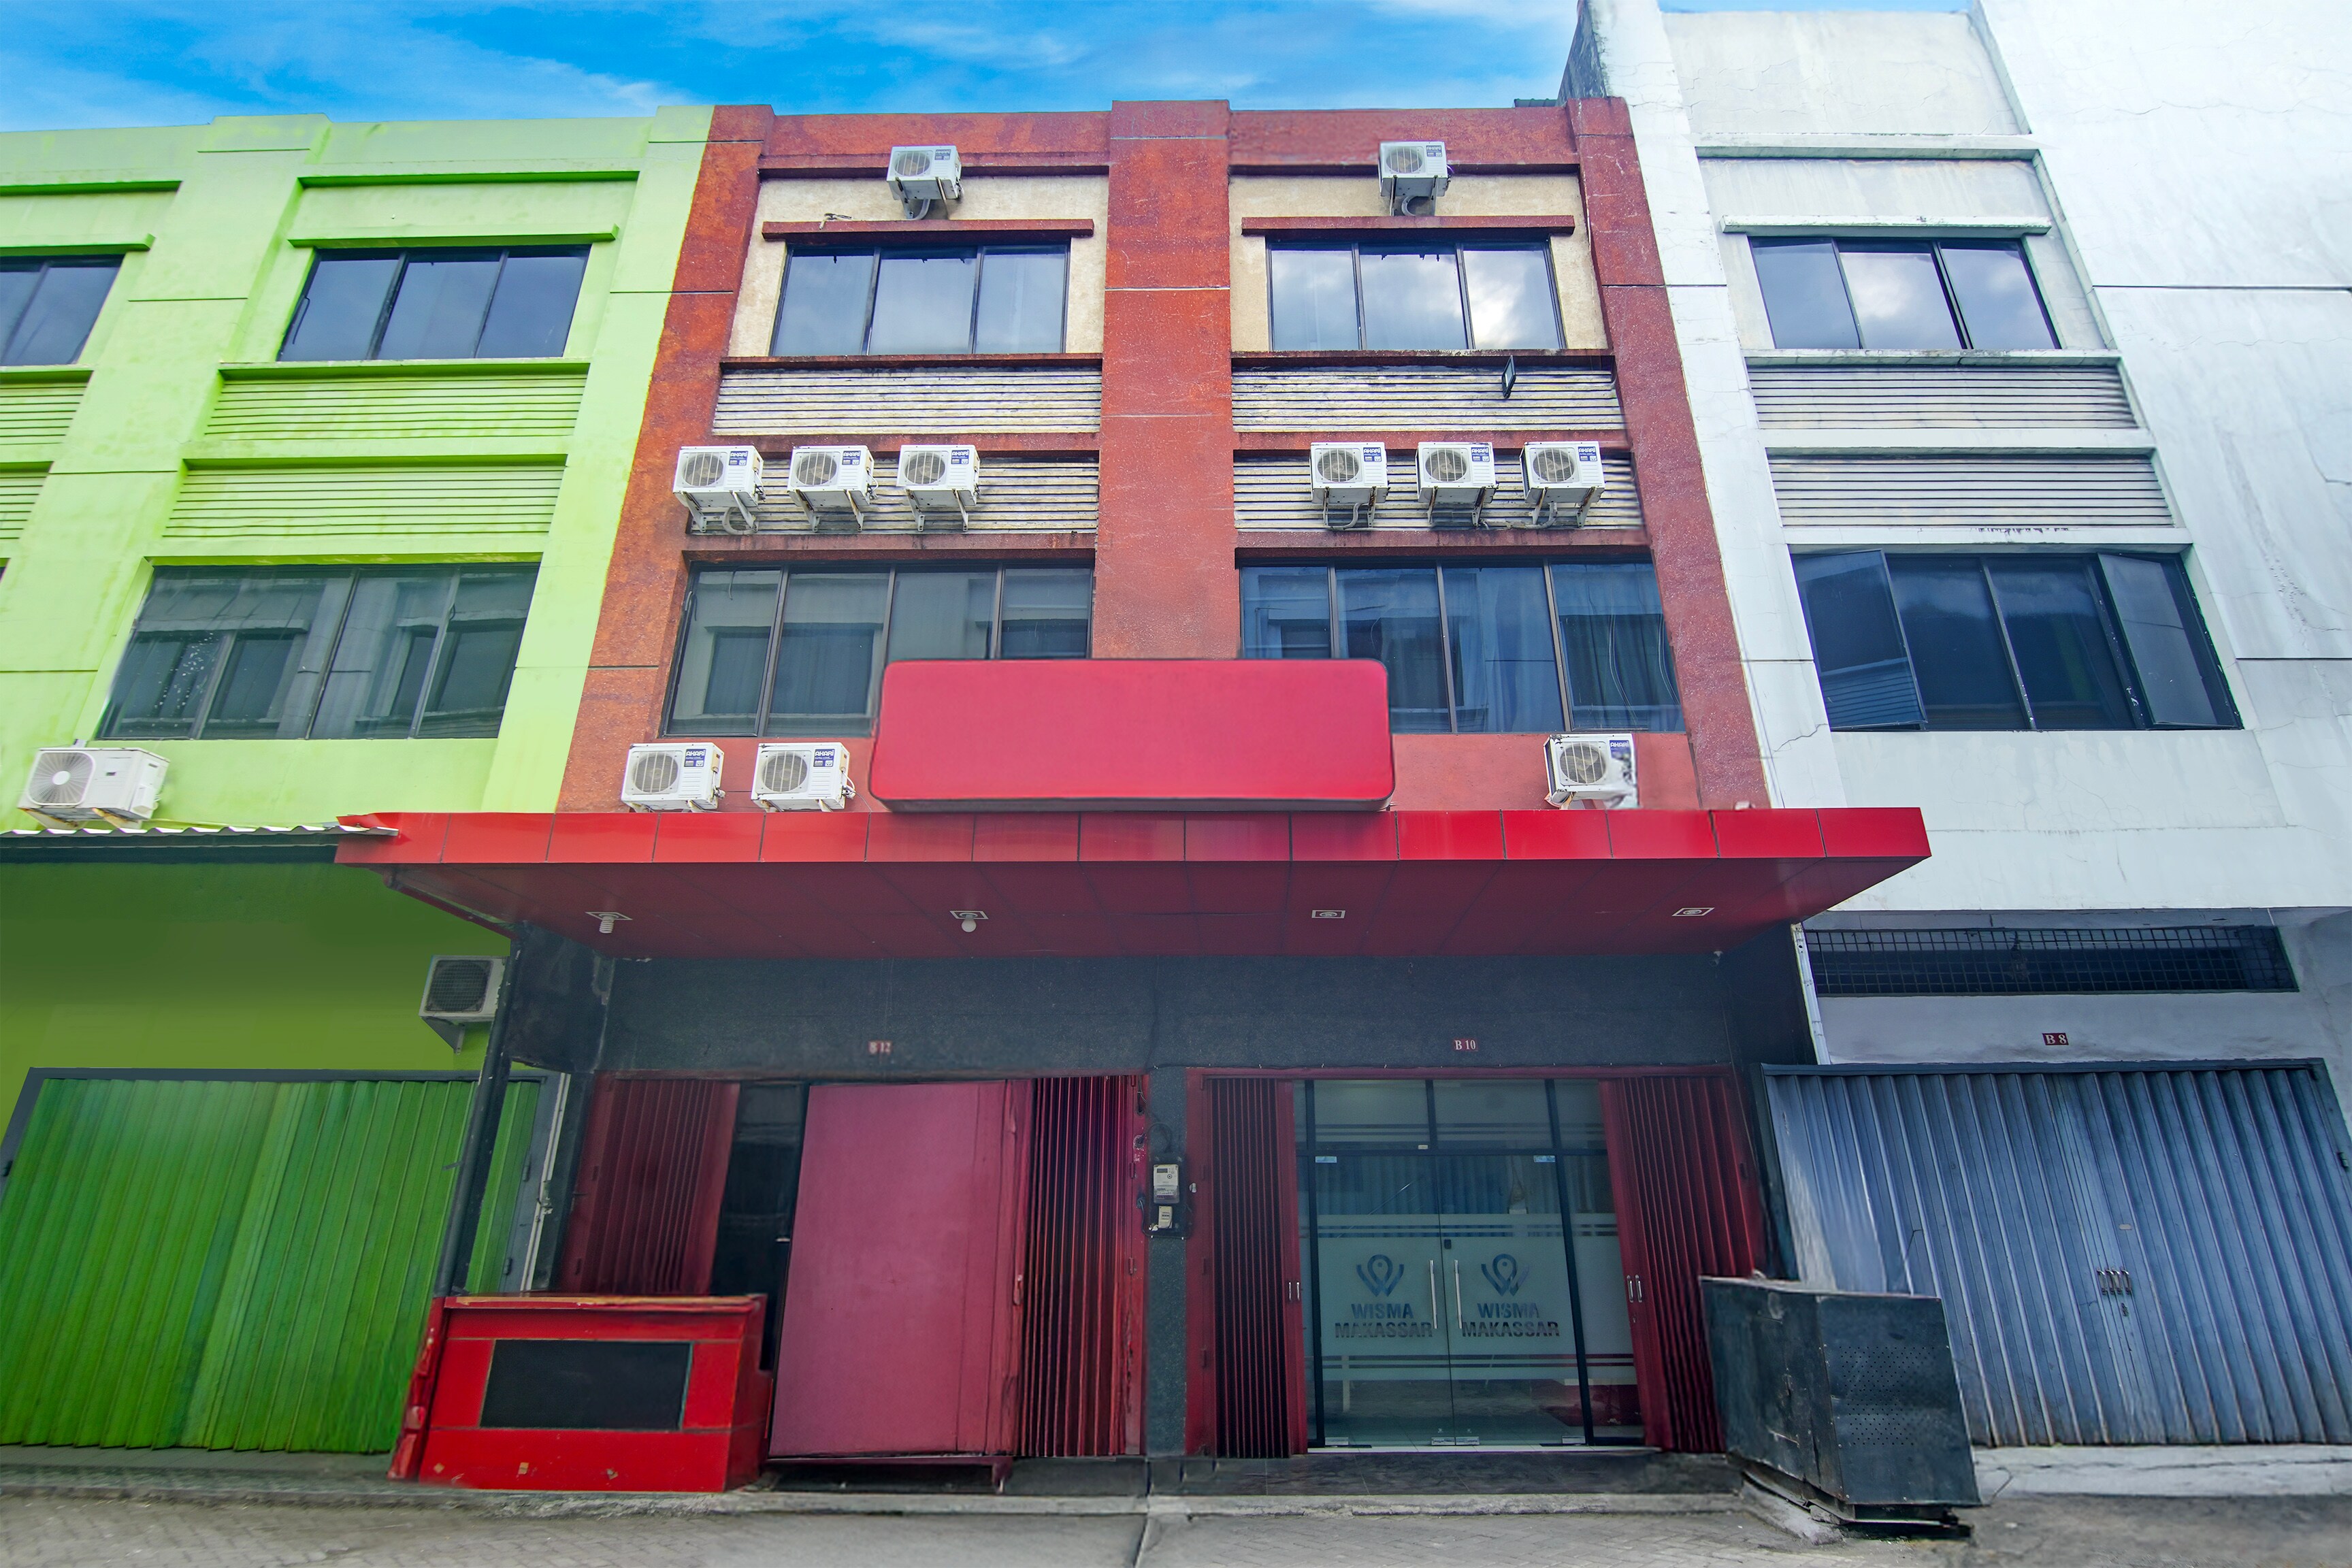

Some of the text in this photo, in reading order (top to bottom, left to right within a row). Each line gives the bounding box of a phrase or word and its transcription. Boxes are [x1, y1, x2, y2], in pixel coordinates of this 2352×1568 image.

[1351, 1303, 1414, 1318] WISMA
[1477, 1303, 1539, 1318] WISMA
[1335, 1322, 1433, 1338] MAKASSAR
[1462, 1322, 1561, 1337] MAKASSAR
